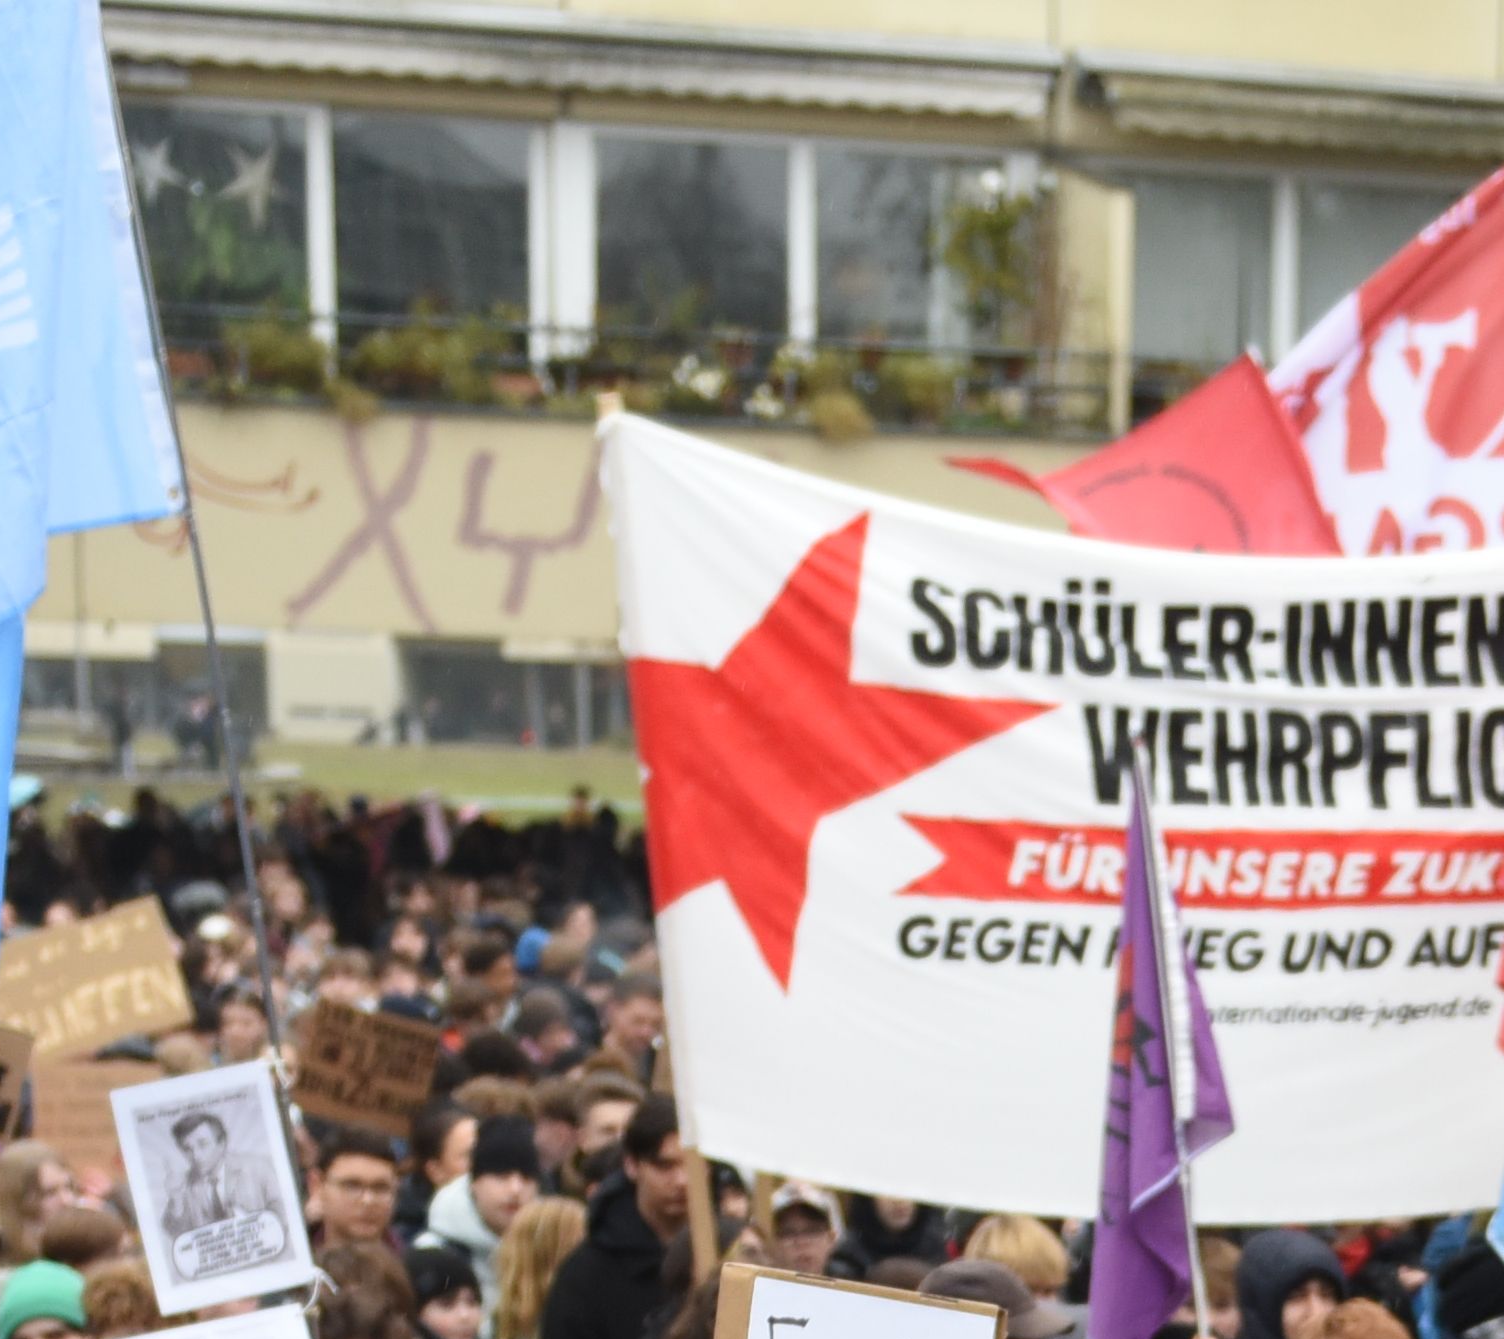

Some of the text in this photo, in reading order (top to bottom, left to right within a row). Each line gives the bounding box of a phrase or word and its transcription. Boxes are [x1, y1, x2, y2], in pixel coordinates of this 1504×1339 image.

[1006, 833, 1125, 891] FÜR
[898, 916, 1092, 968] GEGEN
[1280, 929, 1392, 973] UND
